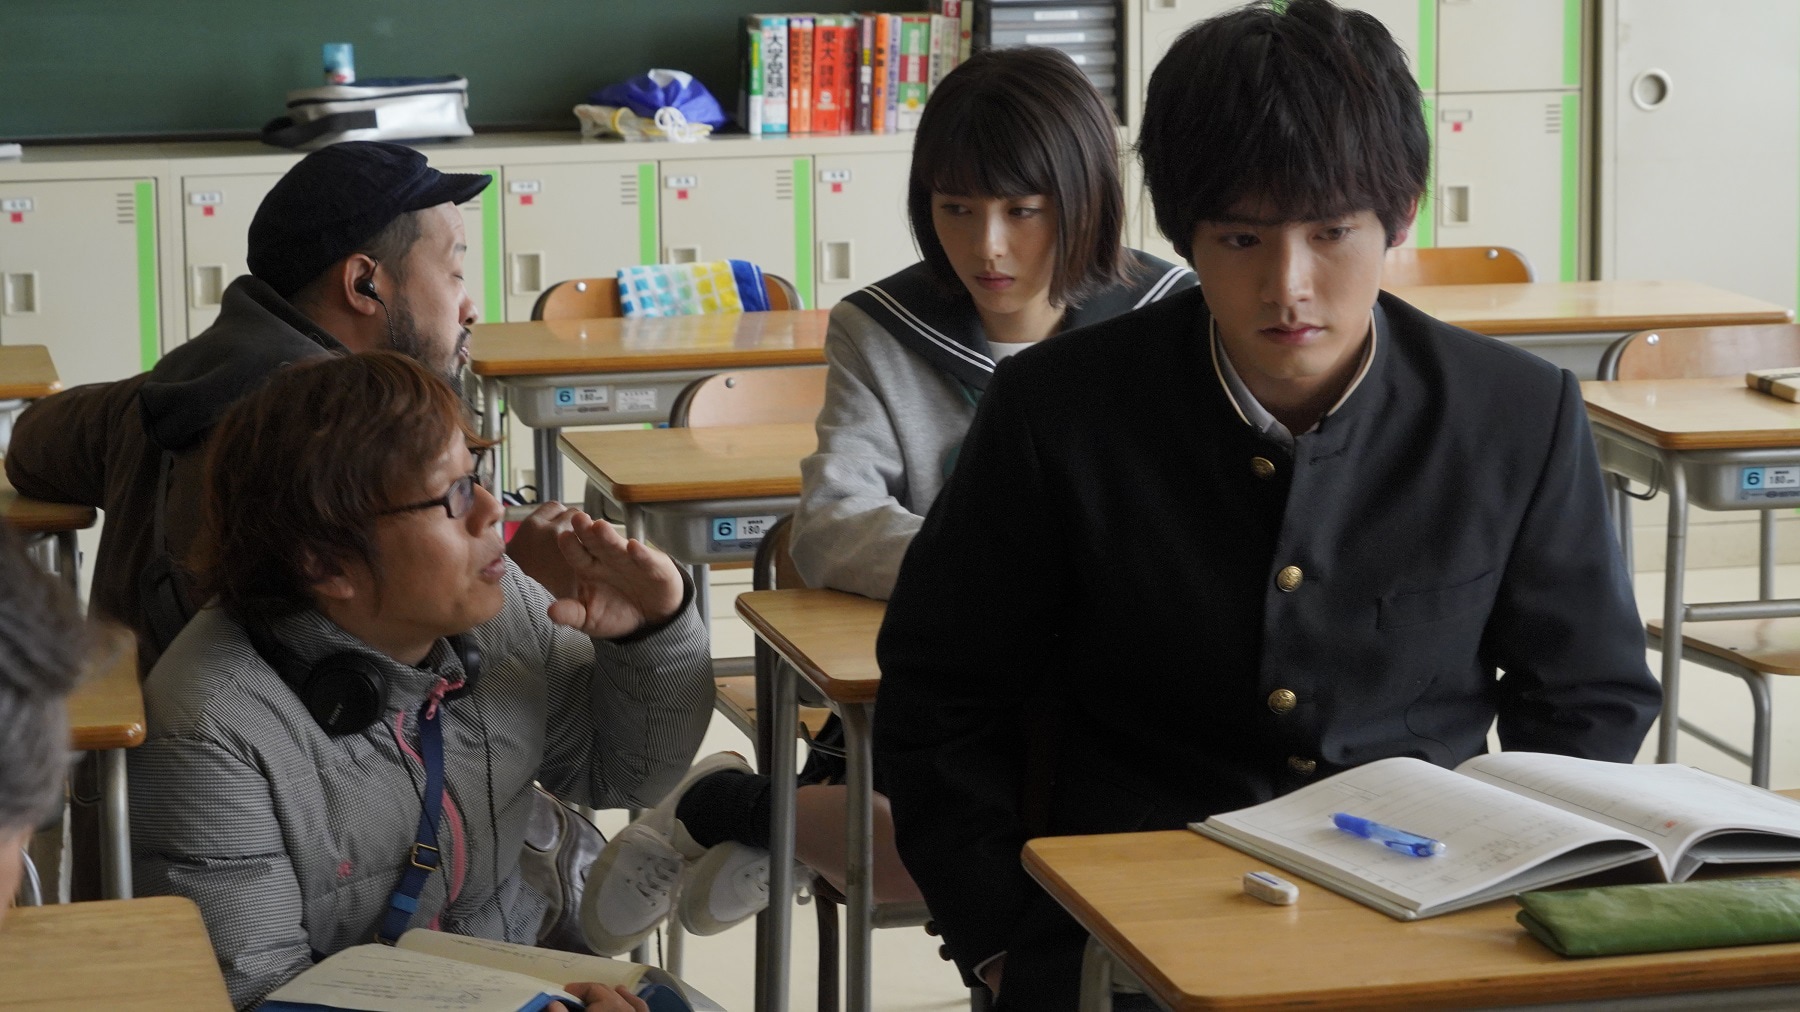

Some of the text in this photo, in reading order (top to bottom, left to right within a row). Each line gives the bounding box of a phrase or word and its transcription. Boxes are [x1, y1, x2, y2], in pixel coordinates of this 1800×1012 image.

[559, 390, 571, 403] 6
[1747, 471, 1760, 486] 6
[718, 522, 732, 536] 6
